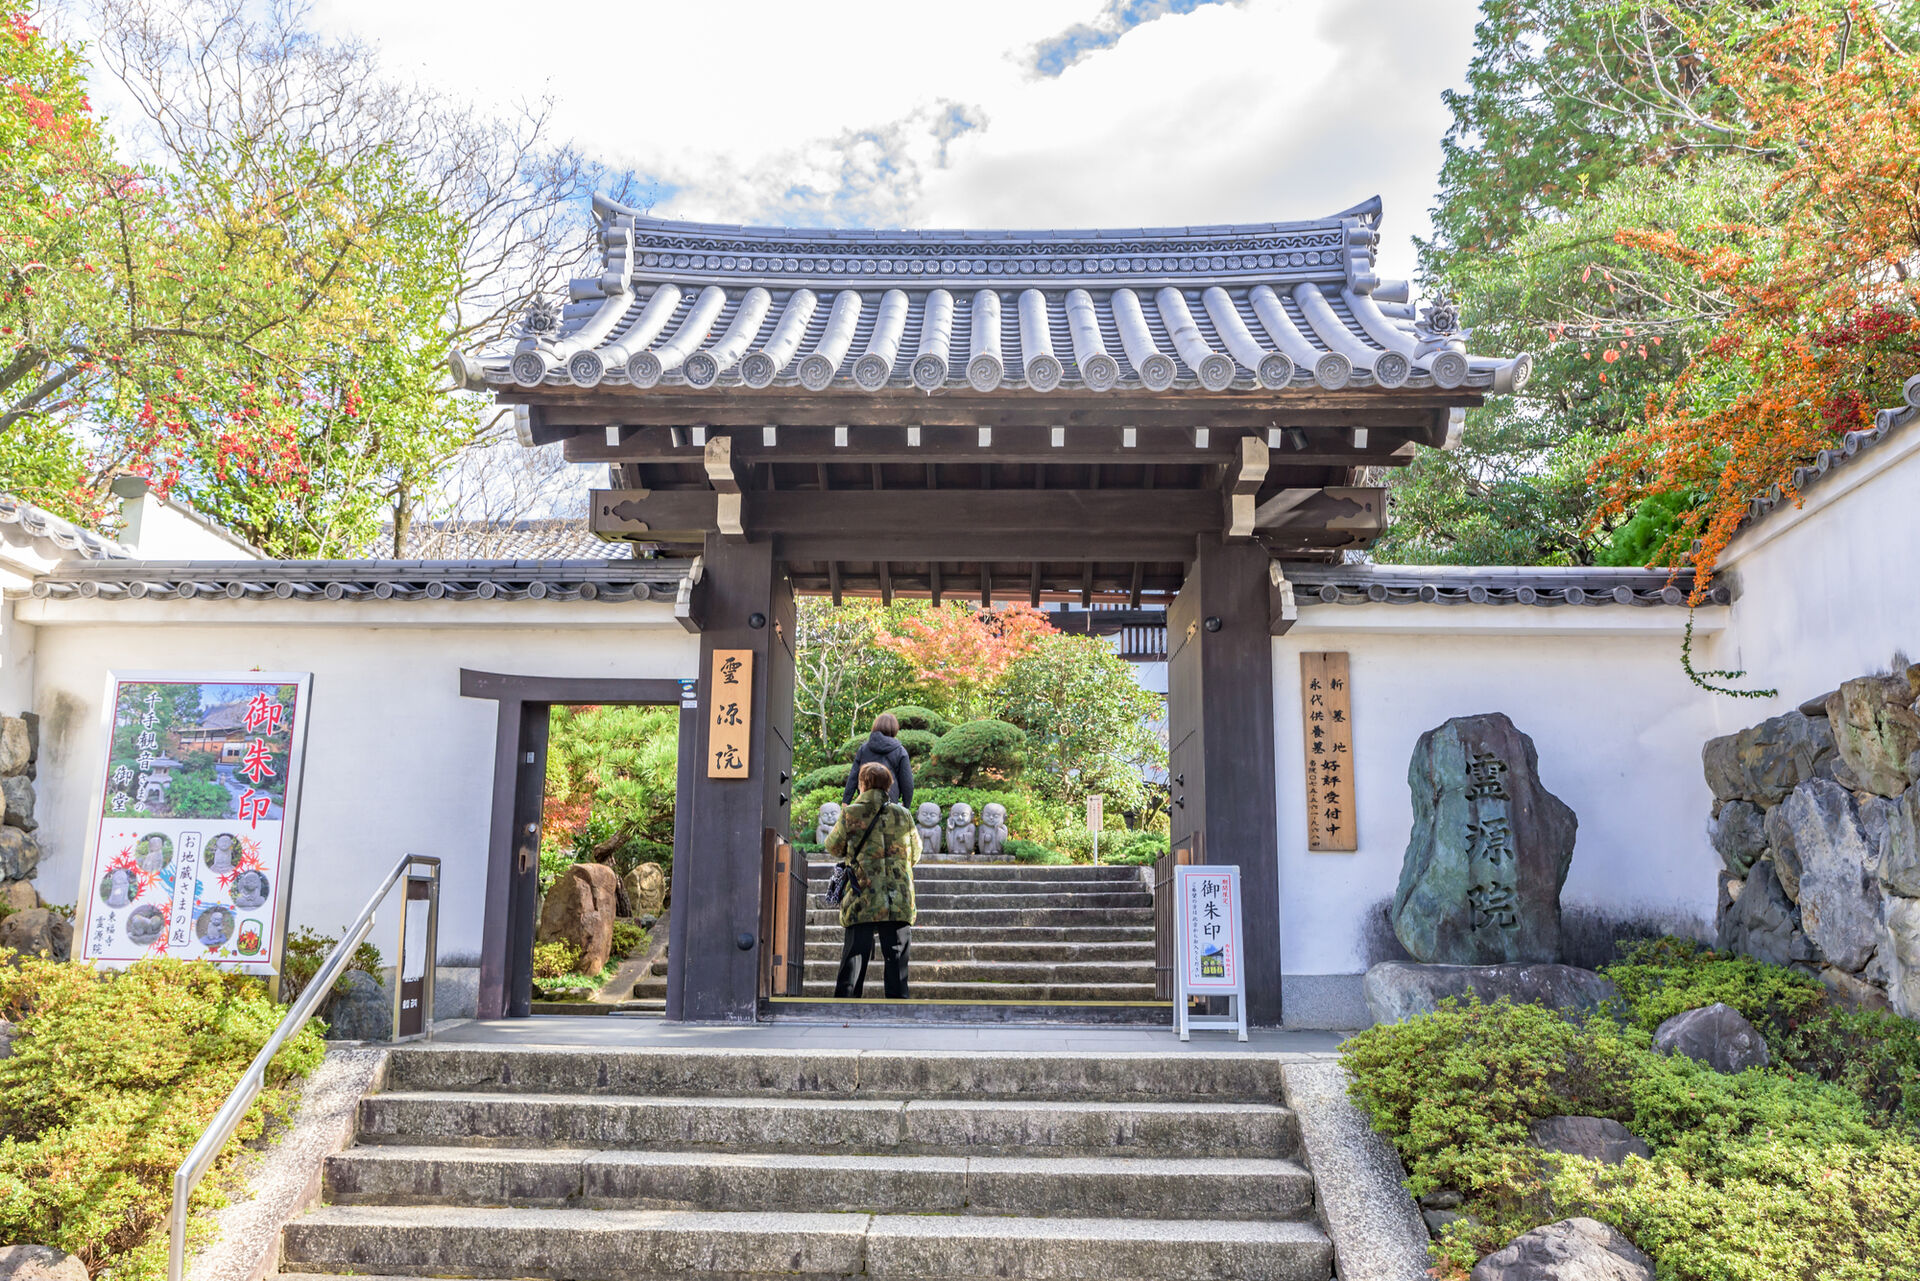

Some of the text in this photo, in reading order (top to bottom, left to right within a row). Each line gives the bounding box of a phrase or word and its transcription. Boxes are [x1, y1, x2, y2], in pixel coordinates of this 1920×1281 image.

[112, 766, 134, 812] 御堂
[135, 691, 162, 812] 千手観音さまの
[238, 692, 283, 830] 御朱印
[1321, 759, 1342, 837] 好評受付中
[172, 835, 196, 944] お地蔵さまの庭
[1200, 879, 1221, 941] 御朱印
